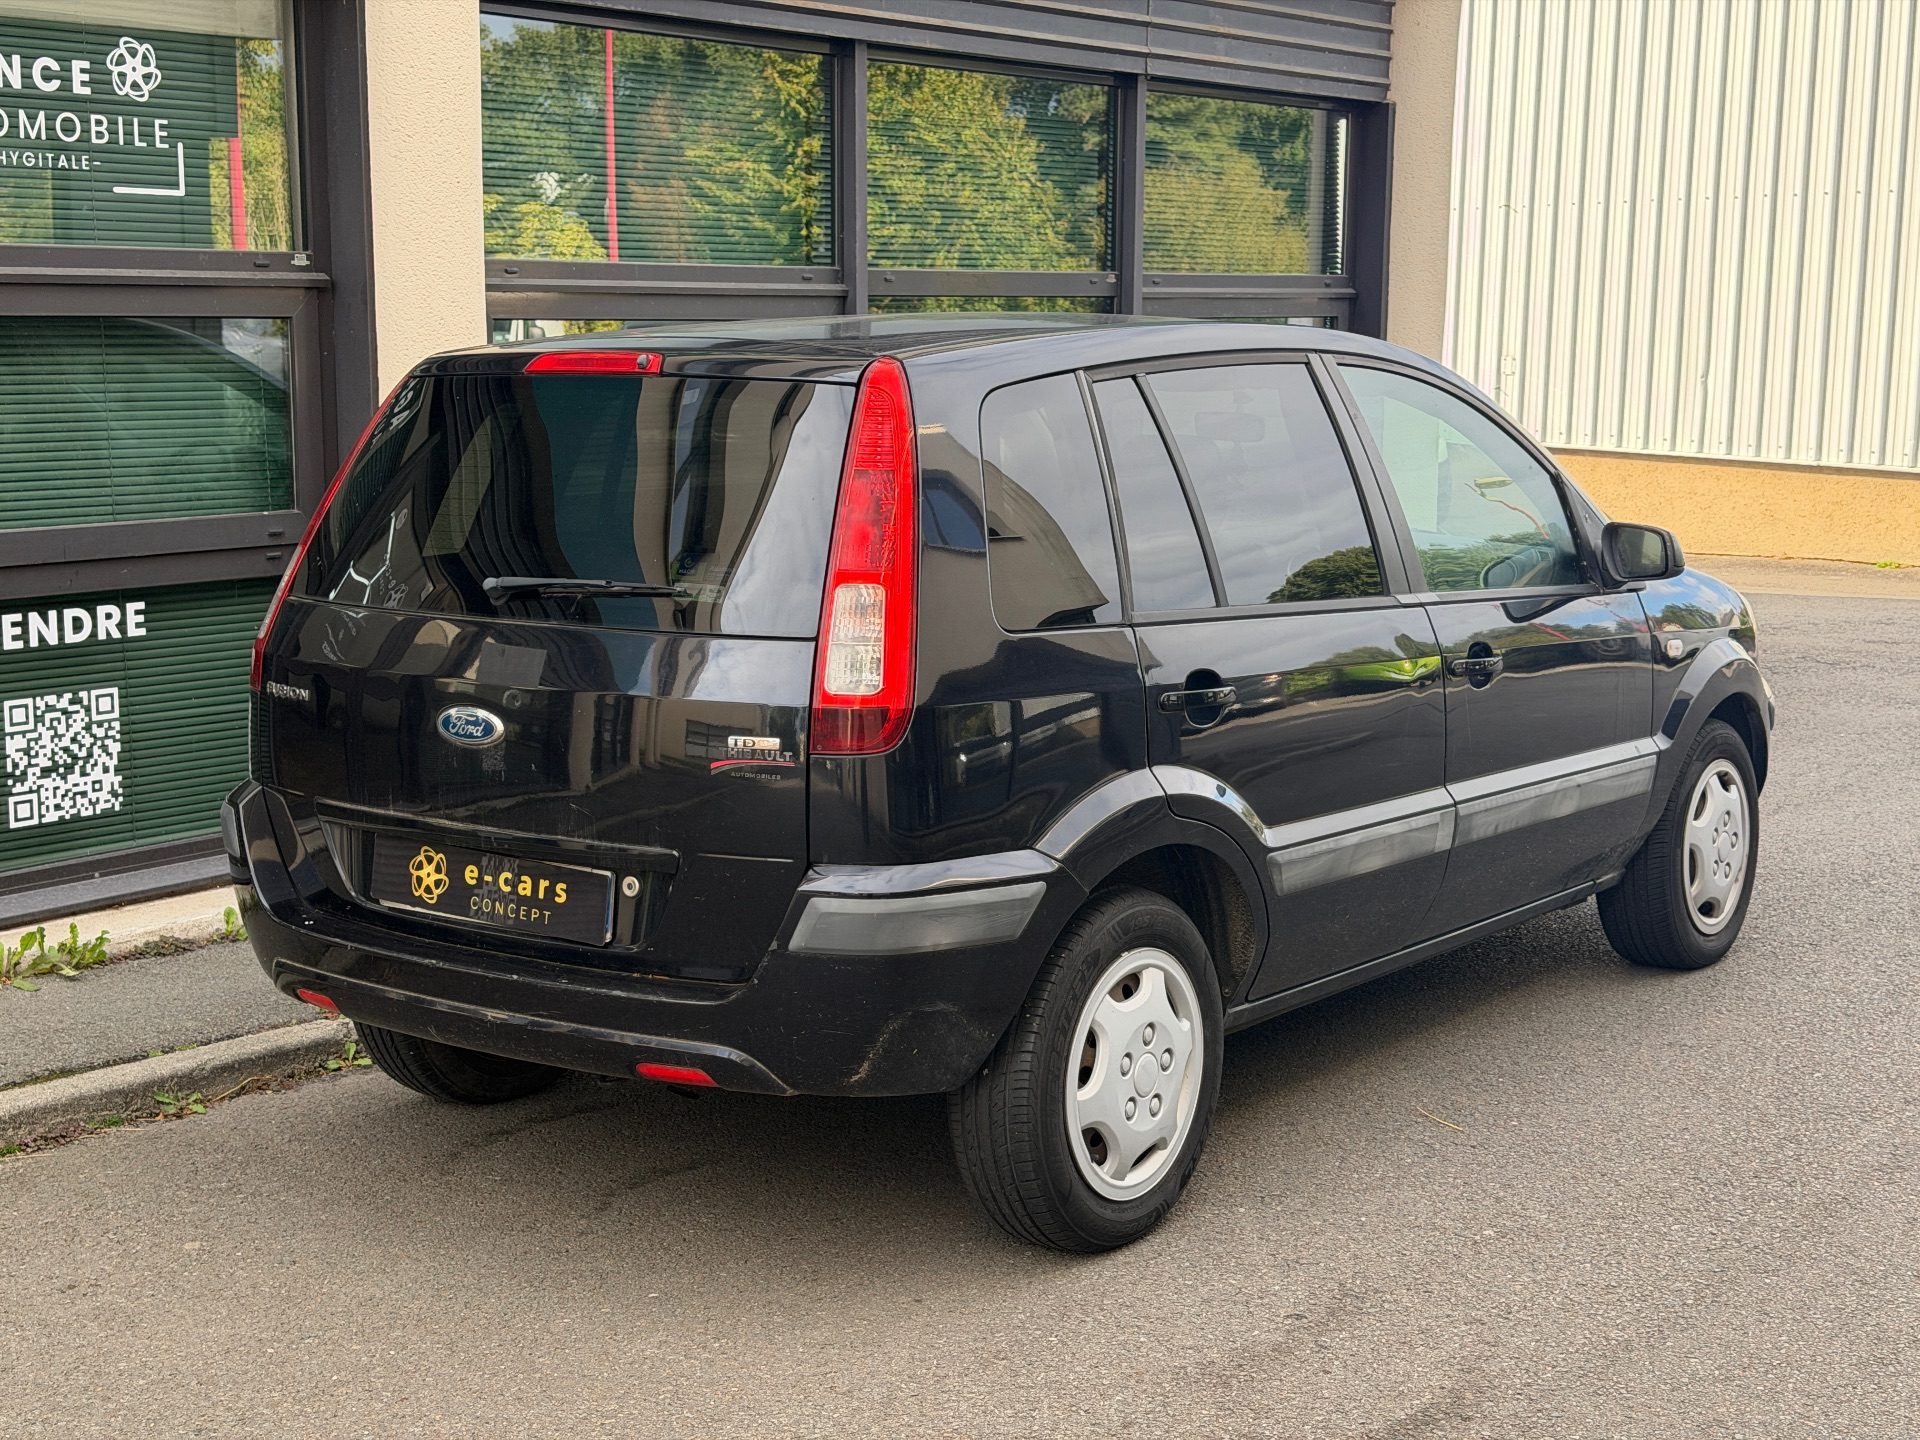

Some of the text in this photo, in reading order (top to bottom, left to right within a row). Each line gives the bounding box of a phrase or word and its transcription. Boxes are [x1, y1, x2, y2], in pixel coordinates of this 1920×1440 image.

[1, 601, 147, 650] ENDRE
[266, 680, 309, 701] FUSION
[448, 713, 486, 737] Ford
[464, 864, 568, 904] e-cars
[470, 896, 551, 925] CONCEPT
